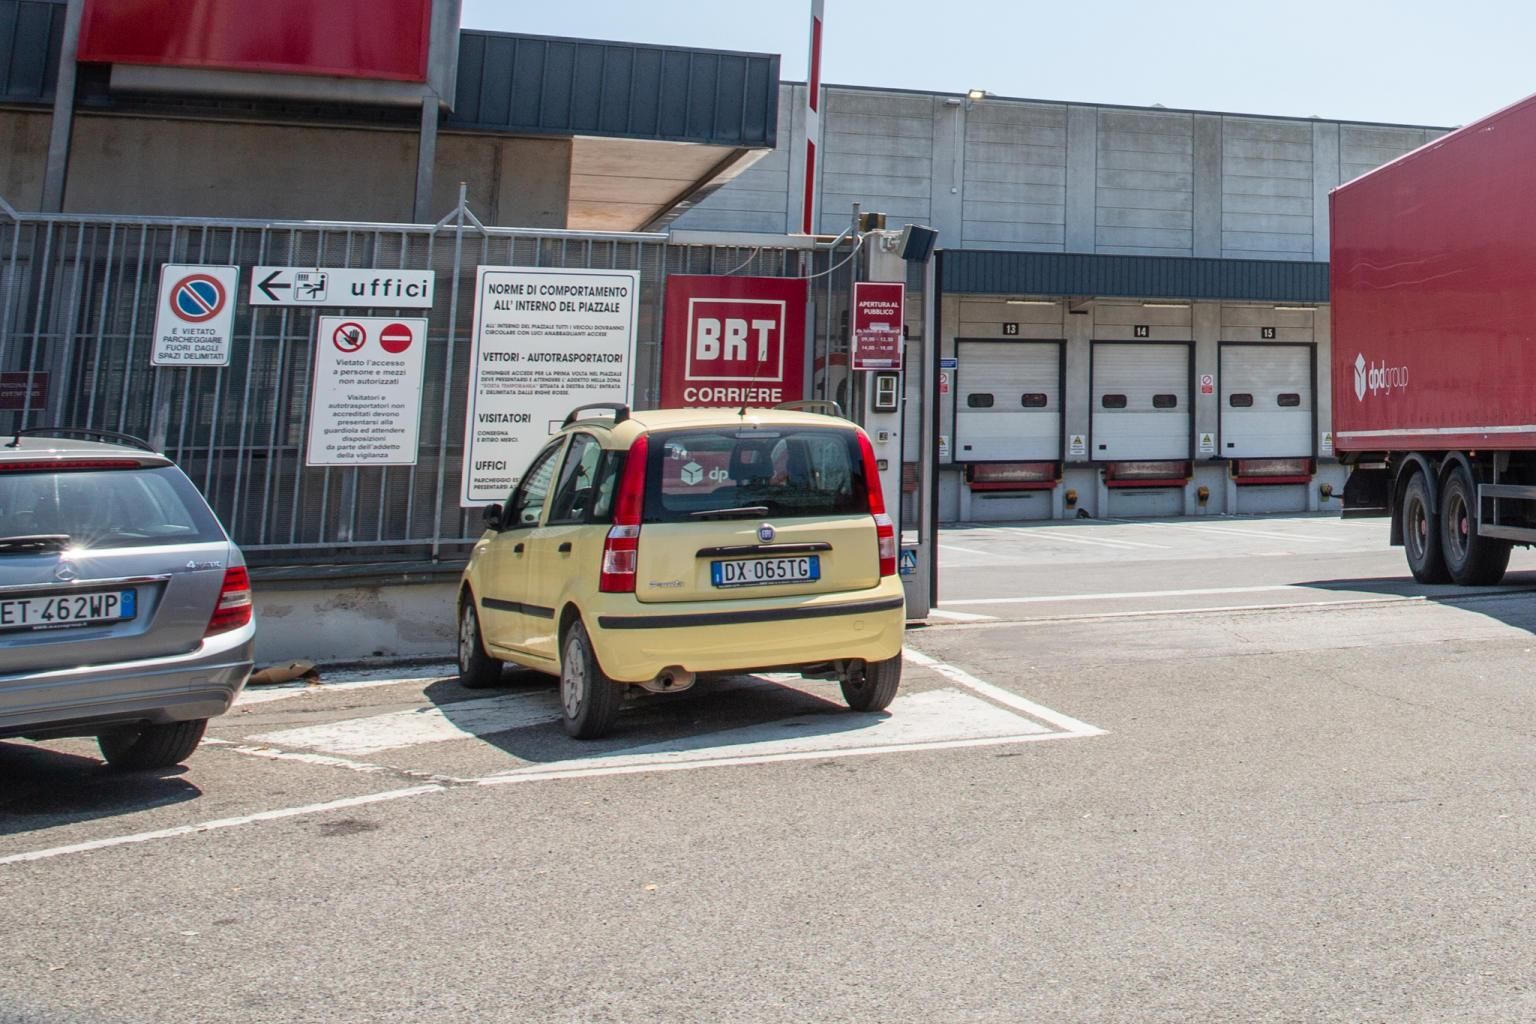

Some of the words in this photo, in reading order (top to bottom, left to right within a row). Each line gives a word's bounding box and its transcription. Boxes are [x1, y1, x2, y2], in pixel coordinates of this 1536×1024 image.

[352, 278, 427, 297] uffici
[489, 284, 524, 295] NORME
[527, 285, 536, 295] DI
[539, 285, 627, 297] COMPORTAMENTO
[516, 301, 556, 311] INTERNO
[560, 302, 576, 312] DEL
[579, 302, 620, 312] PIAZZALE
[1006, 324, 1016, 333] 13
[1137, 327, 1146, 336] 14
[1264, 329, 1272, 337] 15
[696, 318, 776, 361] BRT
[483, 352, 519, 362] VETTORI
[528, 353, 622, 363] AUTOTRASPORTATORI
[1369, 360, 1408, 396] dpdgroup
[684, 388, 782, 402] CORRIERE
[479, 413, 531, 423] VISITATORI
[475, 461, 506, 470] UFFICI
[725, 563, 749, 581] DX
[754, 559, 808, 578] 065TG
